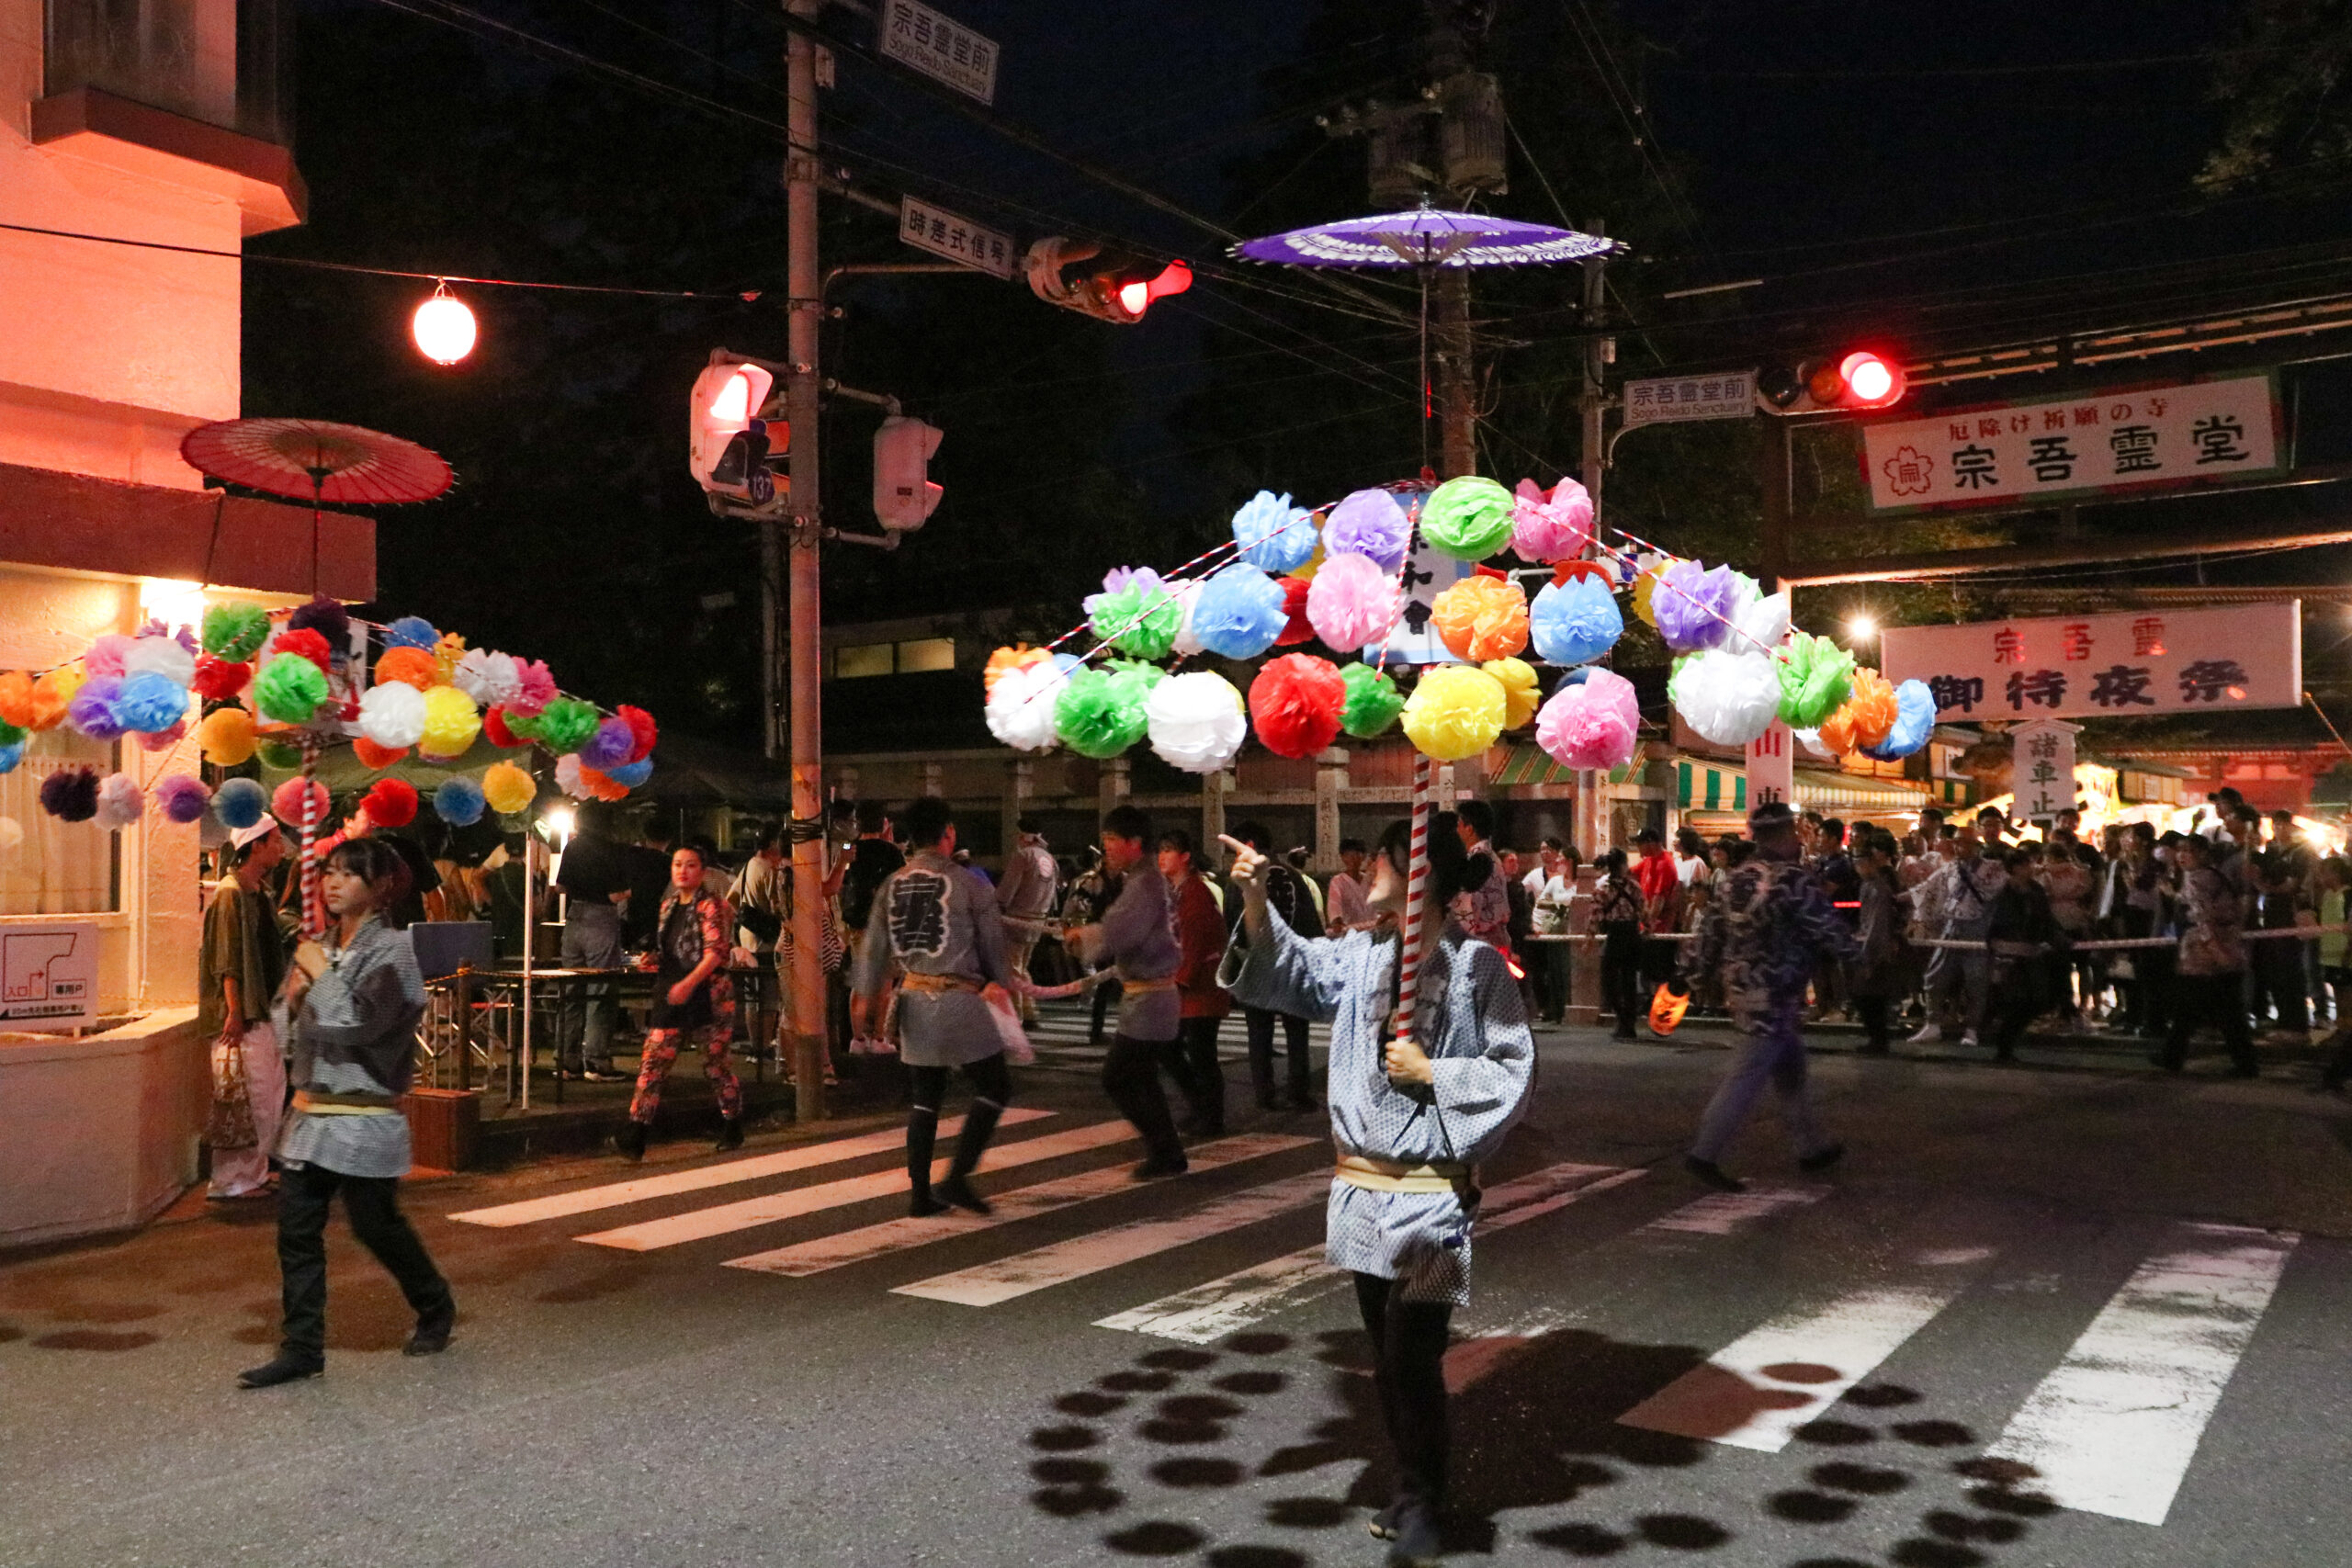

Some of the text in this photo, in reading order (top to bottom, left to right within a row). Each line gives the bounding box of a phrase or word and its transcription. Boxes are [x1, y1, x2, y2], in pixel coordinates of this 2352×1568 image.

[909, 209, 1004, 265] 時差式信号
[1631, 407, 1658, 421] Sogo
[1692, 401, 1747, 414] Sanctuary
[1949, 398, 2169, 442] 厄除け祈願の寺
[1951, 414, 2250, 491] 宗吾霊堂
[752, 475, 773, 501] 137
[1930, 660, 2250, 715] 御待夜祭
[2028, 732, 2060, 816] 諸車止
[6, 986, 28, 998] 入口
